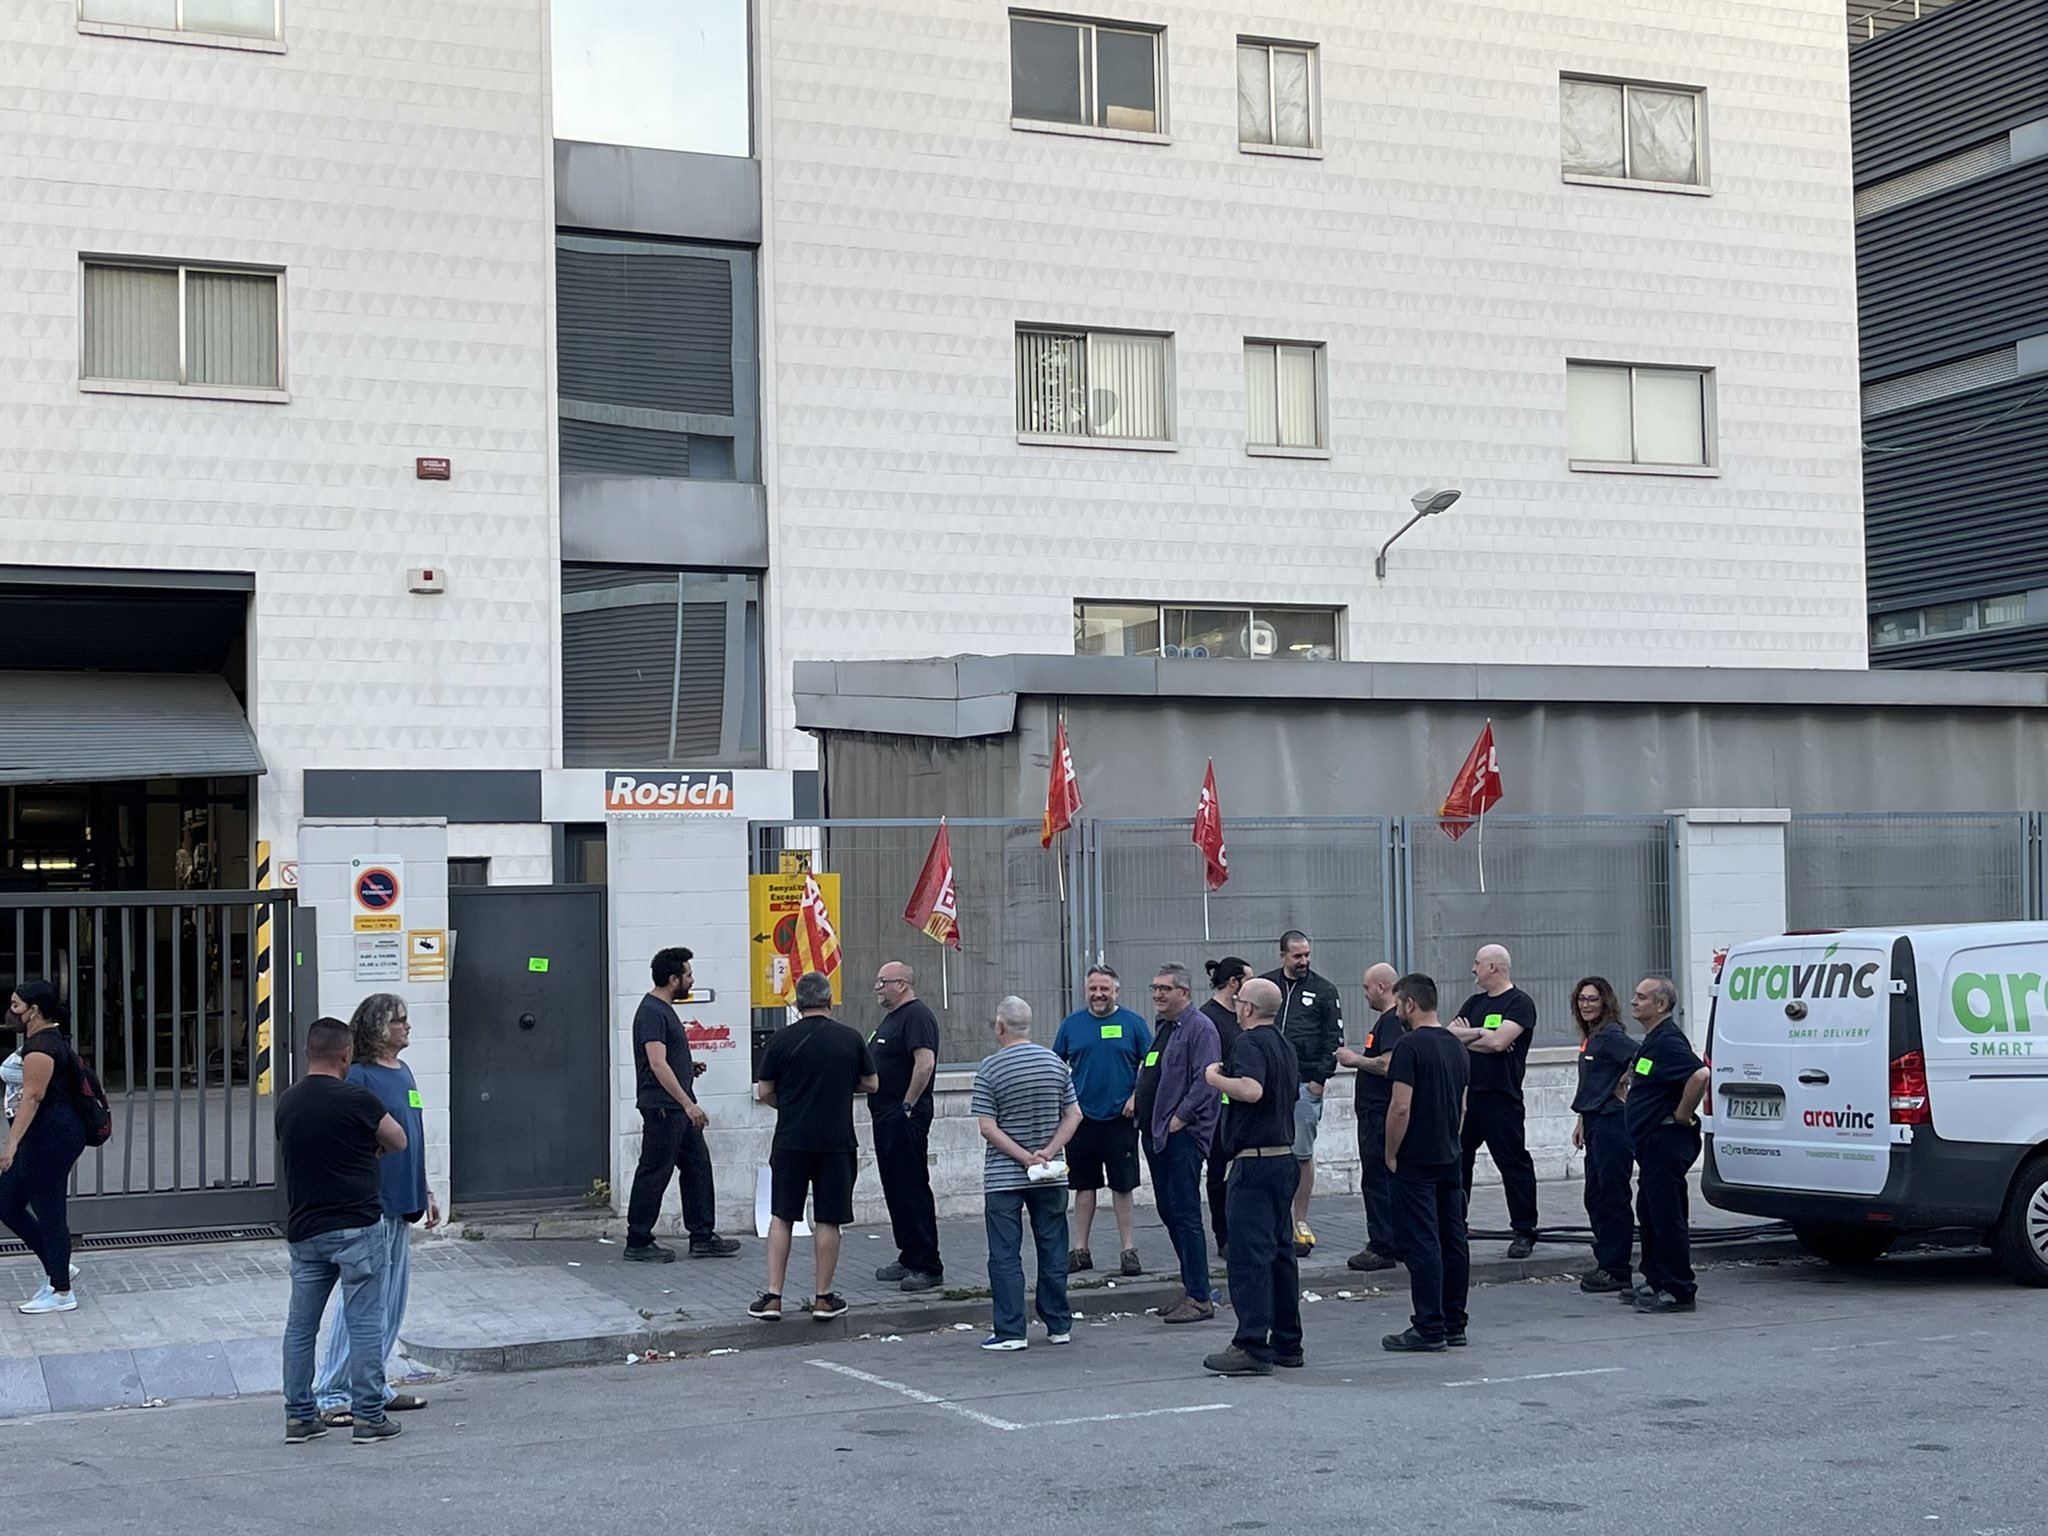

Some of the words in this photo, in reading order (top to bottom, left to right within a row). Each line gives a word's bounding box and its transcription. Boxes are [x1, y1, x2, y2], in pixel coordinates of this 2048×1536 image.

[610, 775, 729, 805] Rosich
[1728, 962, 1880, 1001] aravinc
[1951, 972, 2048, 1034] ar
[1788, 1029, 1818, 1038] SMART
[1823, 1028, 1871, 1038] DELIVERY
[1969, 1042, 2033, 1056] SMART
[1733, 1099, 1758, 1116] 7162
[1760, 1101, 1781, 1117] LVK
[1803, 1104, 1875, 1129] aravinc
